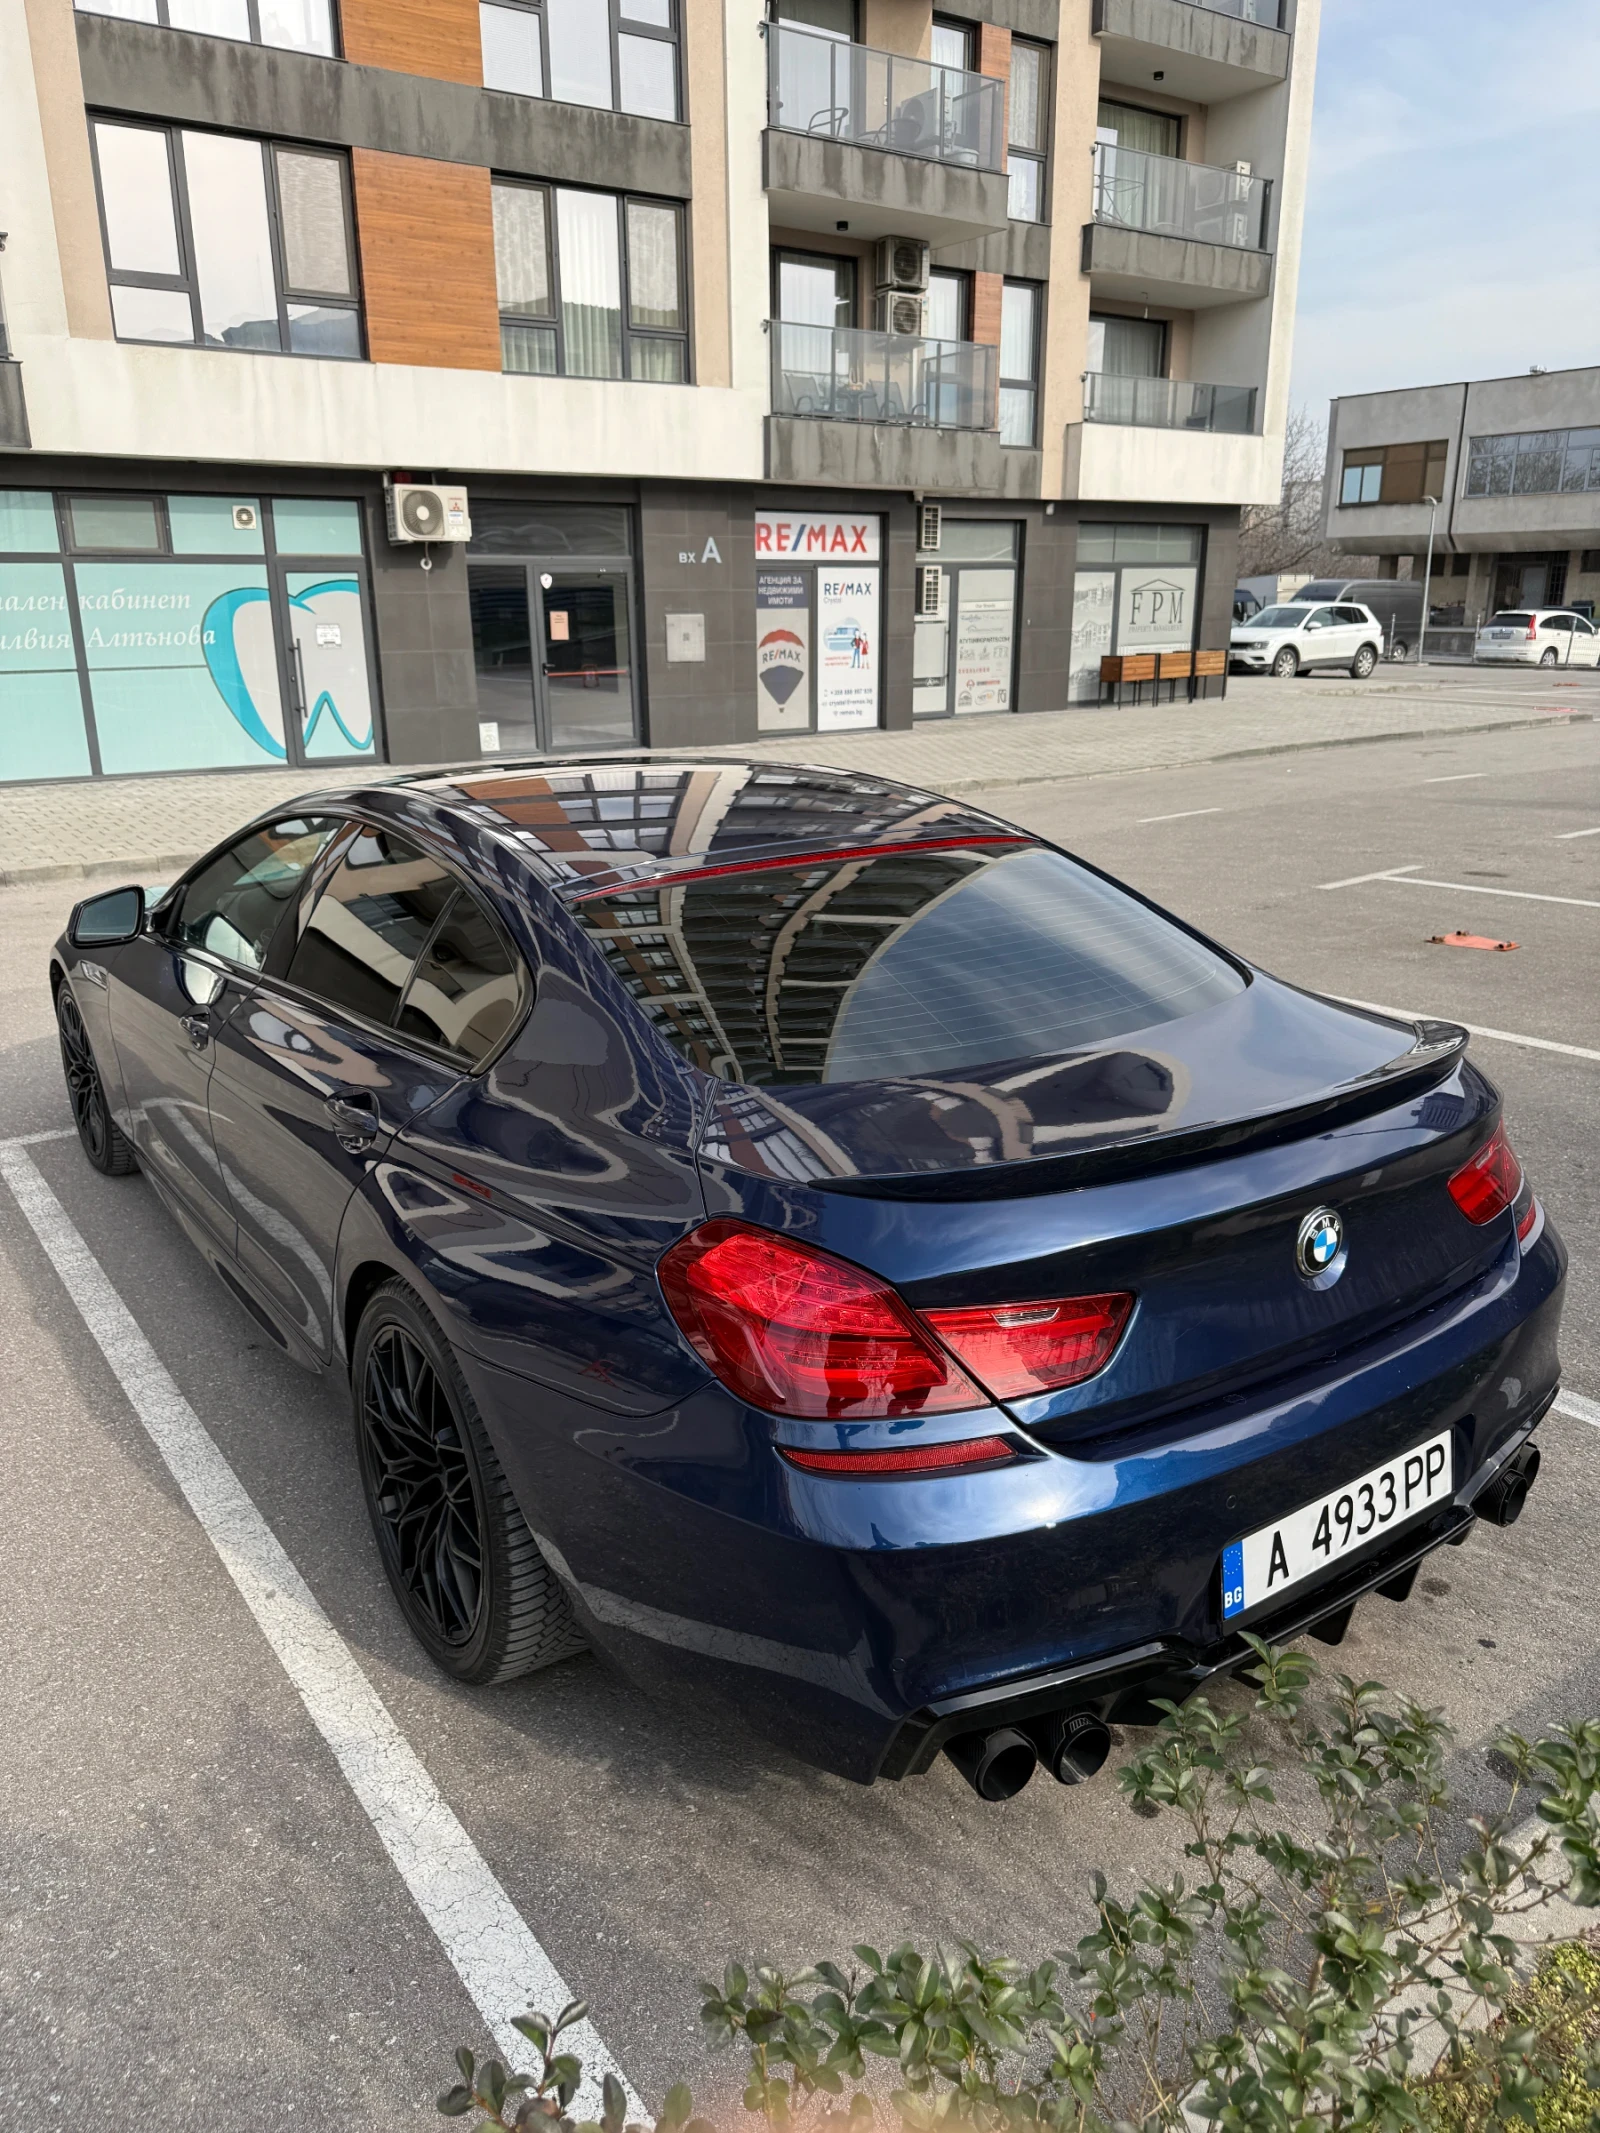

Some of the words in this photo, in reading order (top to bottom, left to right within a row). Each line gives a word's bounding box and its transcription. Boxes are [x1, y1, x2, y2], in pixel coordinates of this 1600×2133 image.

[701, 536, 722, 563] А
[755, 523, 867, 553] RE/MAX
[757, 586, 804, 595] НЕДВИЖИМИ
[759, 576, 791, 585] АГЕНЦИЯ
[792, 576, 803, 585] ЗА
[823, 582, 872, 596] RE/MAX
[0, 595, 66, 611] ален
[79, 588, 191, 611] кабинет
[767, 597, 793, 605] ИМОТИ
[87, 625, 216, 648] Алтънова
[762, 649, 802, 664] RE/MAX
[1309, 1217, 1340, 1240] BMW
[1266, 1530, 1290, 1588] A
[1224, 1586, 1242, 1609] BG
